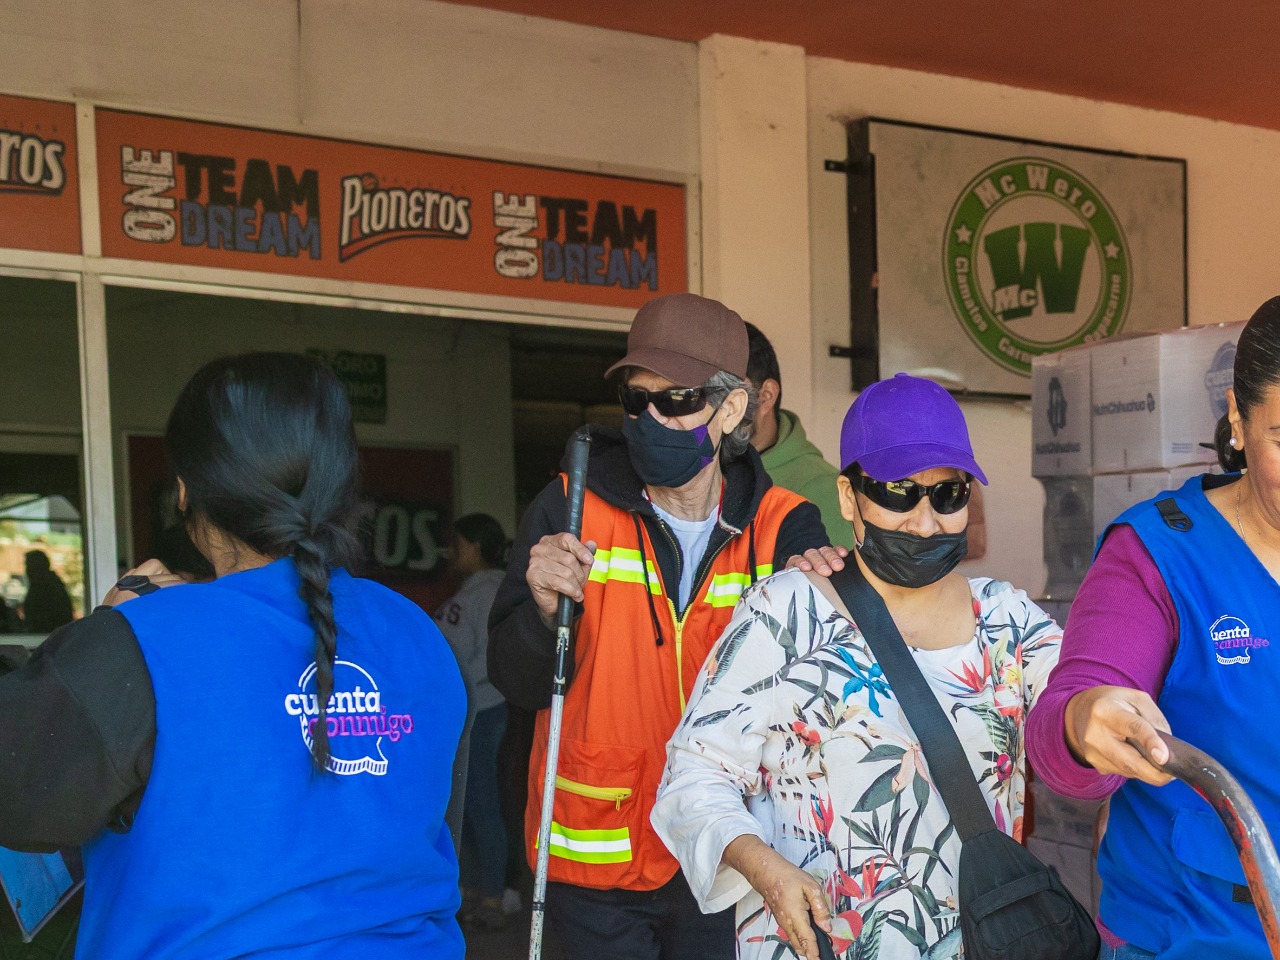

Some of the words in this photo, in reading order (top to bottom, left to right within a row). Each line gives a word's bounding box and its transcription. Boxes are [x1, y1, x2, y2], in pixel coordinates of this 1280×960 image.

[121, 144, 176, 243] ONE
[177, 151, 319, 219] TEAM
[341, 175, 471, 247] Pioneros
[973, 174, 1017, 209] Mc
[1026, 165, 1097, 218] Wero
[181, 200, 321, 260] DREAM
[494, 191, 539, 279] ONE
[540, 196, 658, 253] TEAM
[542, 238, 659, 291] DREAM
[992, 284, 1037, 315] Mc
